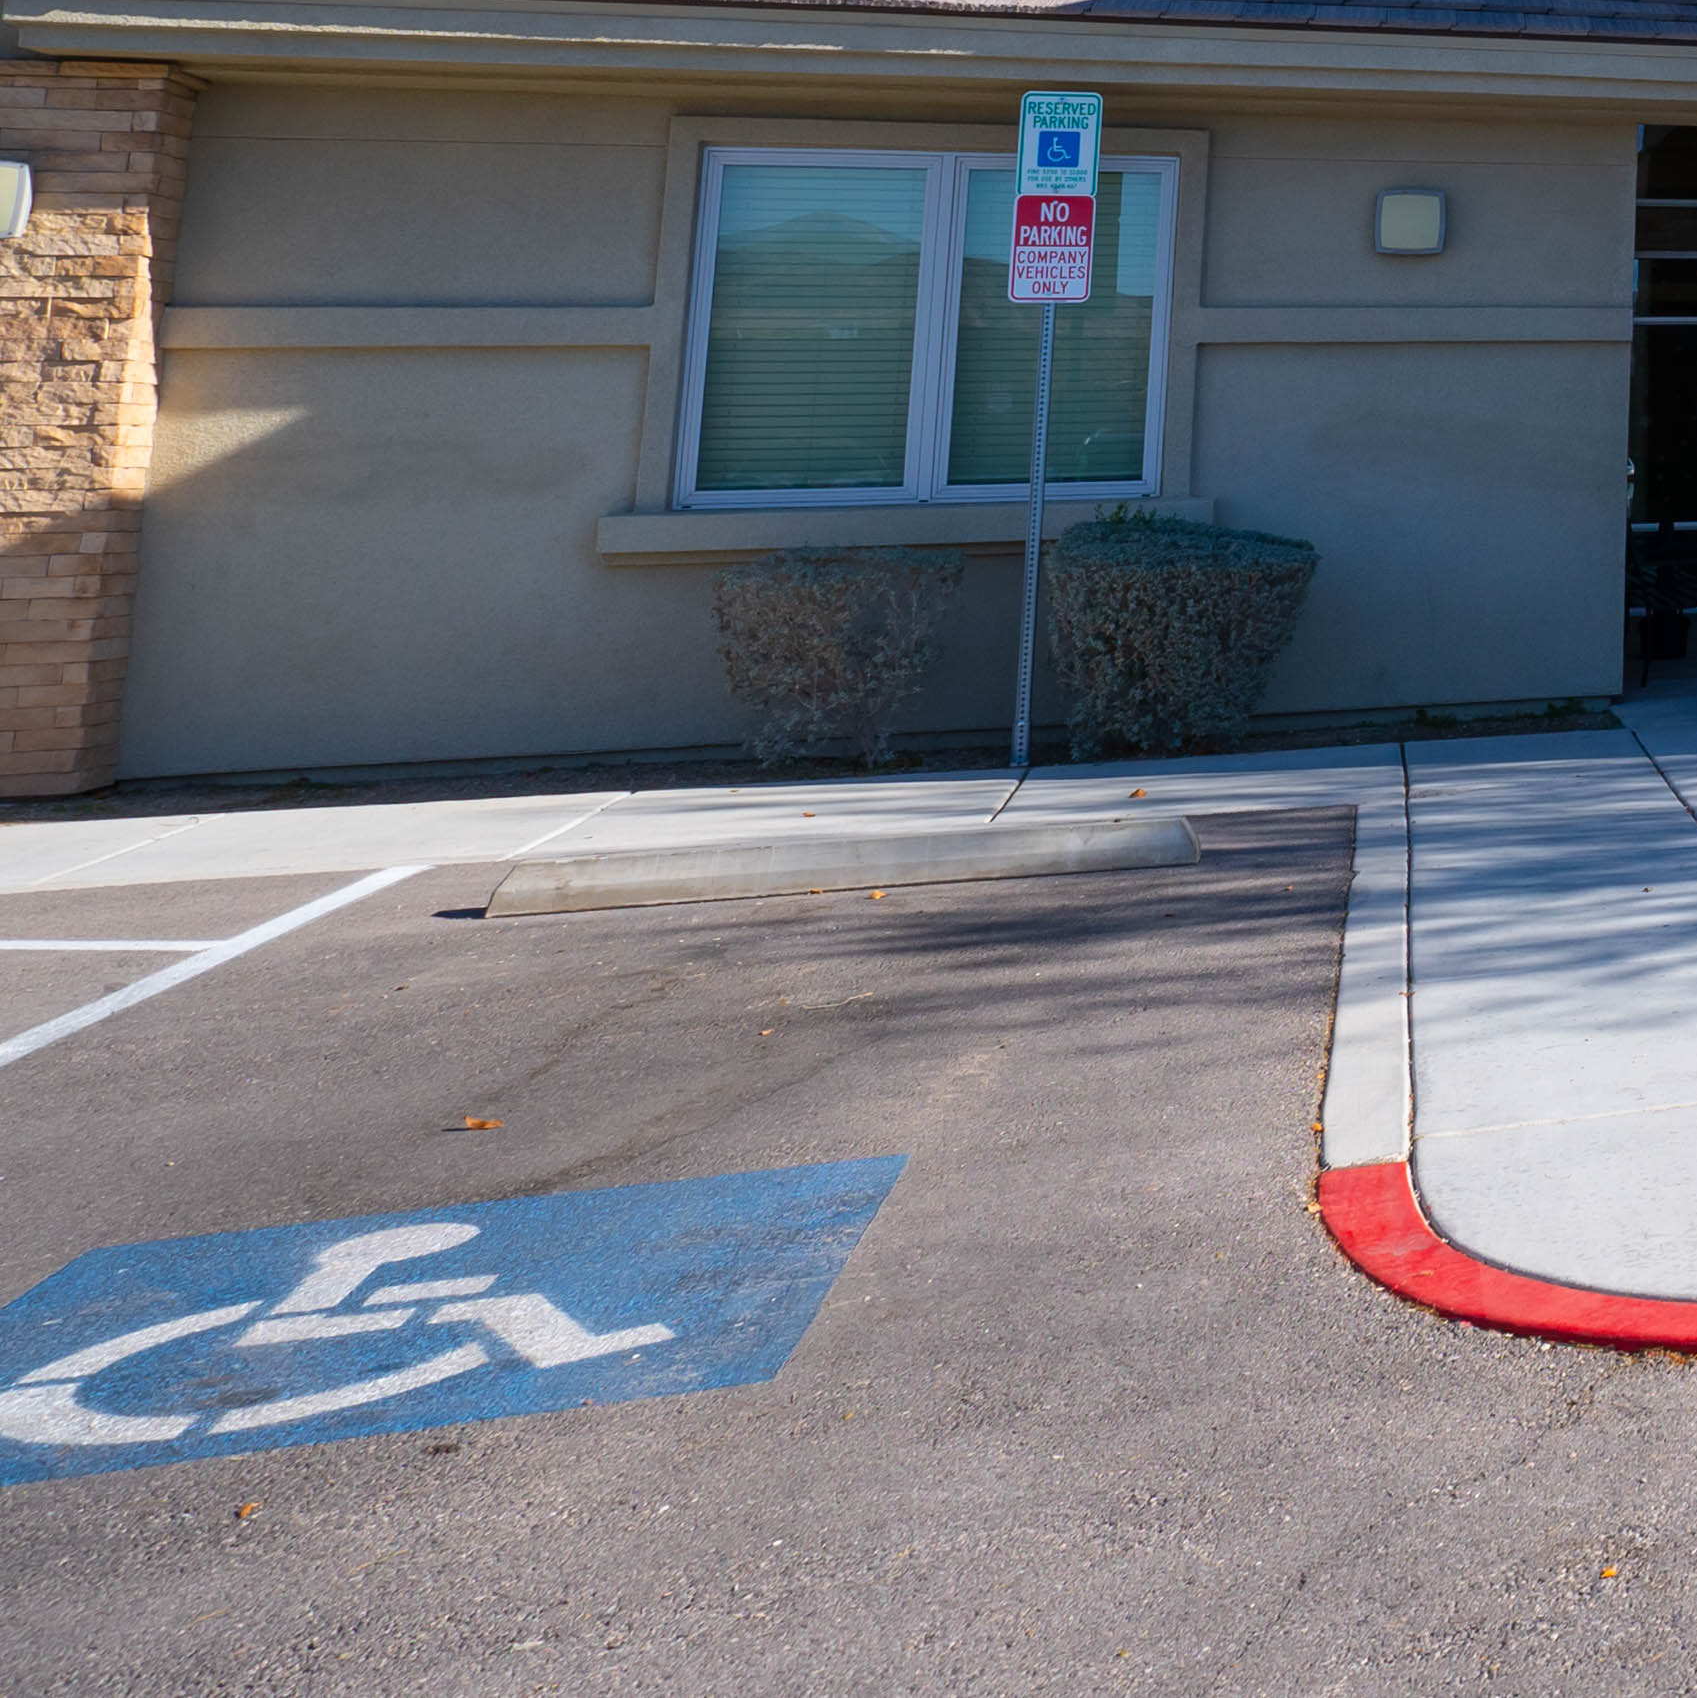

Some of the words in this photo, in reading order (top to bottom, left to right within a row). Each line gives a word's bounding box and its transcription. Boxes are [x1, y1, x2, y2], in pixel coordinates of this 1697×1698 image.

[1027, 101, 1097, 116] RESERVED
[1033, 115, 1089, 129] PARKING
[1040, 201, 1070, 222] NO
[1019, 225, 1088, 246] PARKING
[1017, 250, 1087, 264] COMPANY
[1016, 265, 1086, 279] VEHICLES
[1032, 280, 1069, 295] ONLY
